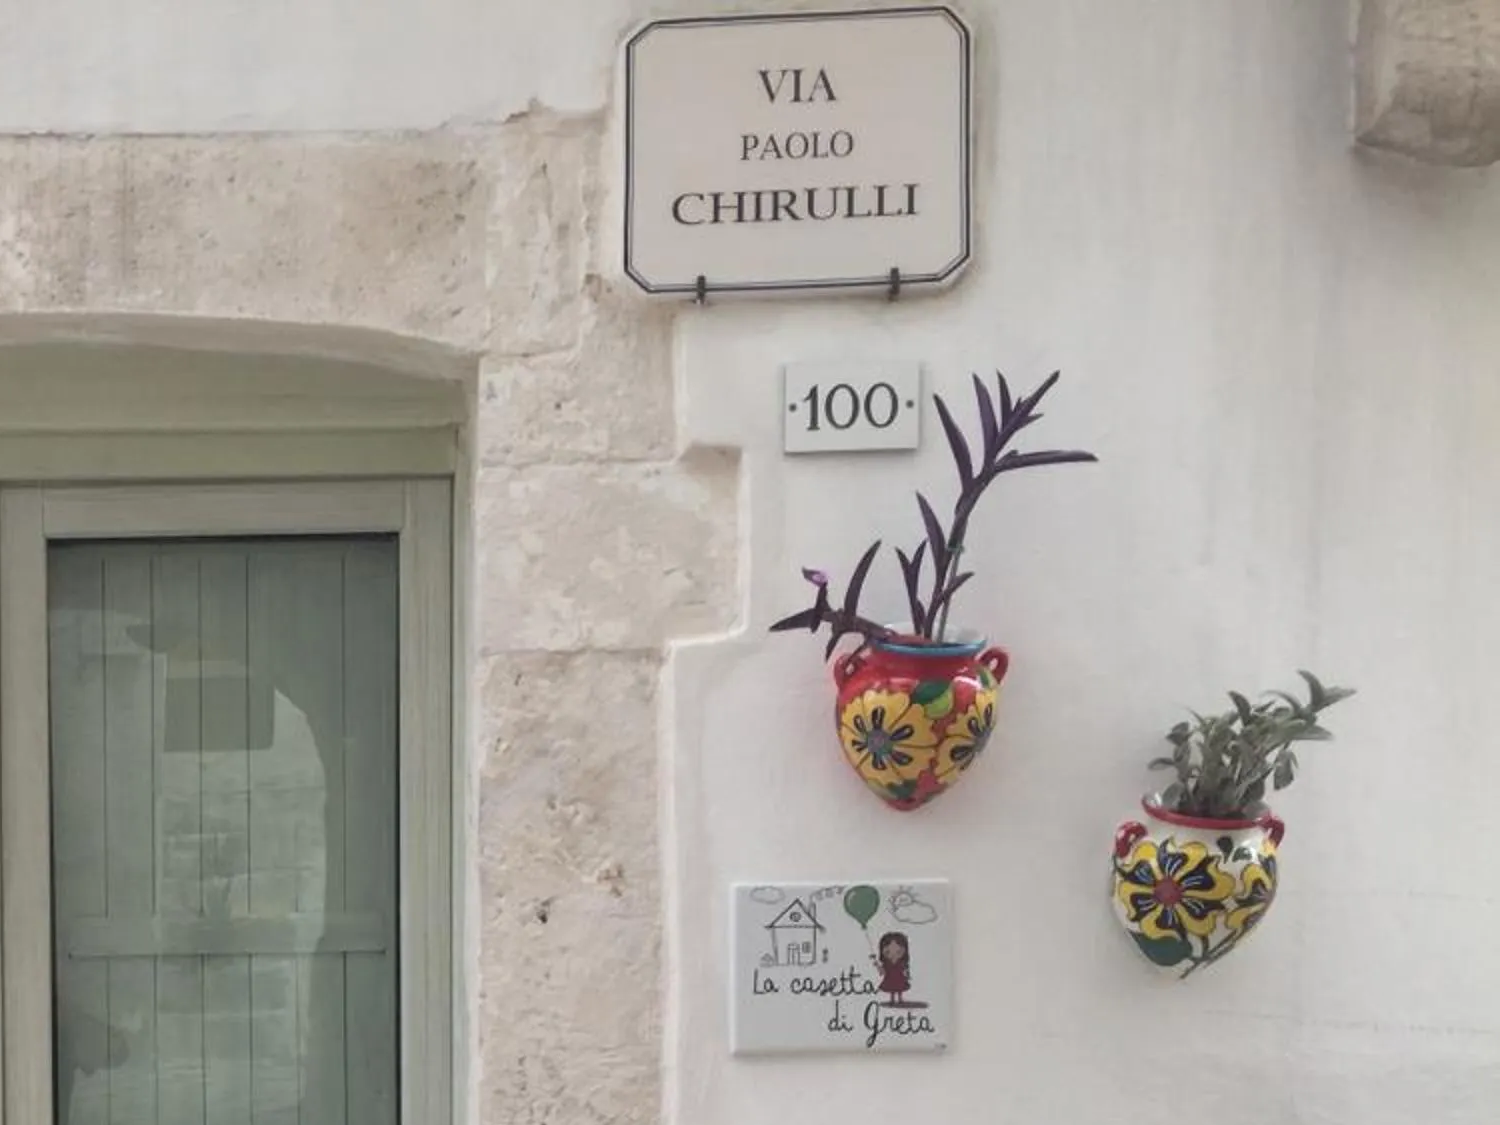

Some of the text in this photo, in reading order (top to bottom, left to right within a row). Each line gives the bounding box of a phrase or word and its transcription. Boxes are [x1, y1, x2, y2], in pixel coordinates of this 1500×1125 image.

[758, 67, 837, 103] VIA
[740, 130, 854, 161] PAOLO
[671, 183, 920, 225] CHIRULLI
[790, 964, 880, 996] casetta
[828, 999, 853, 1032] di
